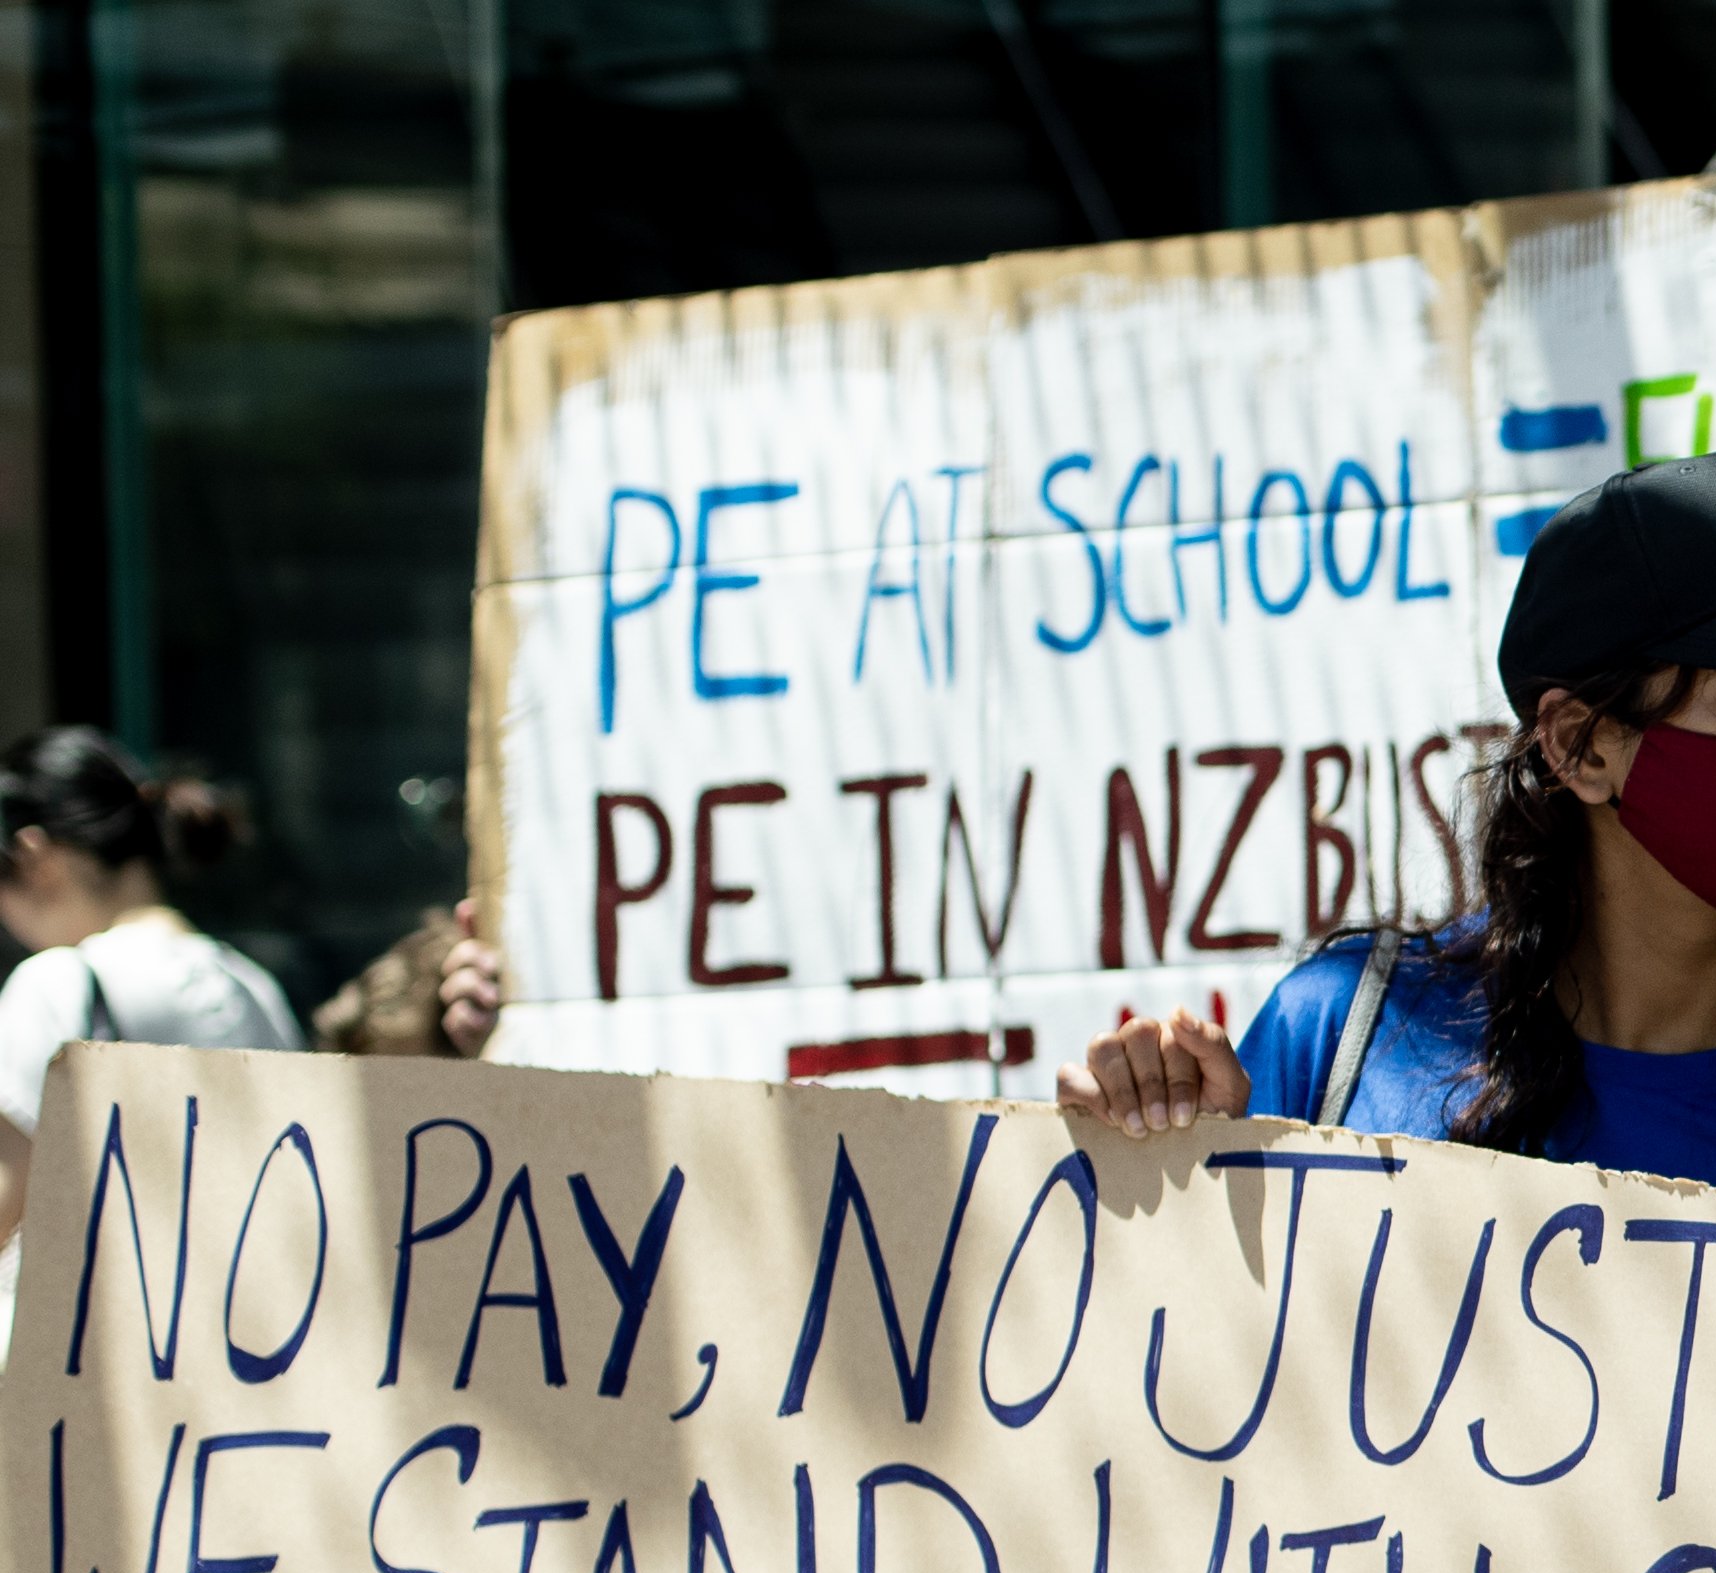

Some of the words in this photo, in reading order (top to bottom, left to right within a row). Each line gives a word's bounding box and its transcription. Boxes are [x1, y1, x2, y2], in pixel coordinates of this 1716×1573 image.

[599, 482, 799, 735] PE
[853, 467, 984, 686] AT
[1036, 441, 1450, 654] SCHOOL
[593, 782, 791, 1003] PE
[840, 769, 1033, 990] IN
[65, 1095, 328, 1384] NO
[378, 1118, 718, 1423] PAY,
[776, 1113, 1099, 1428] NO
